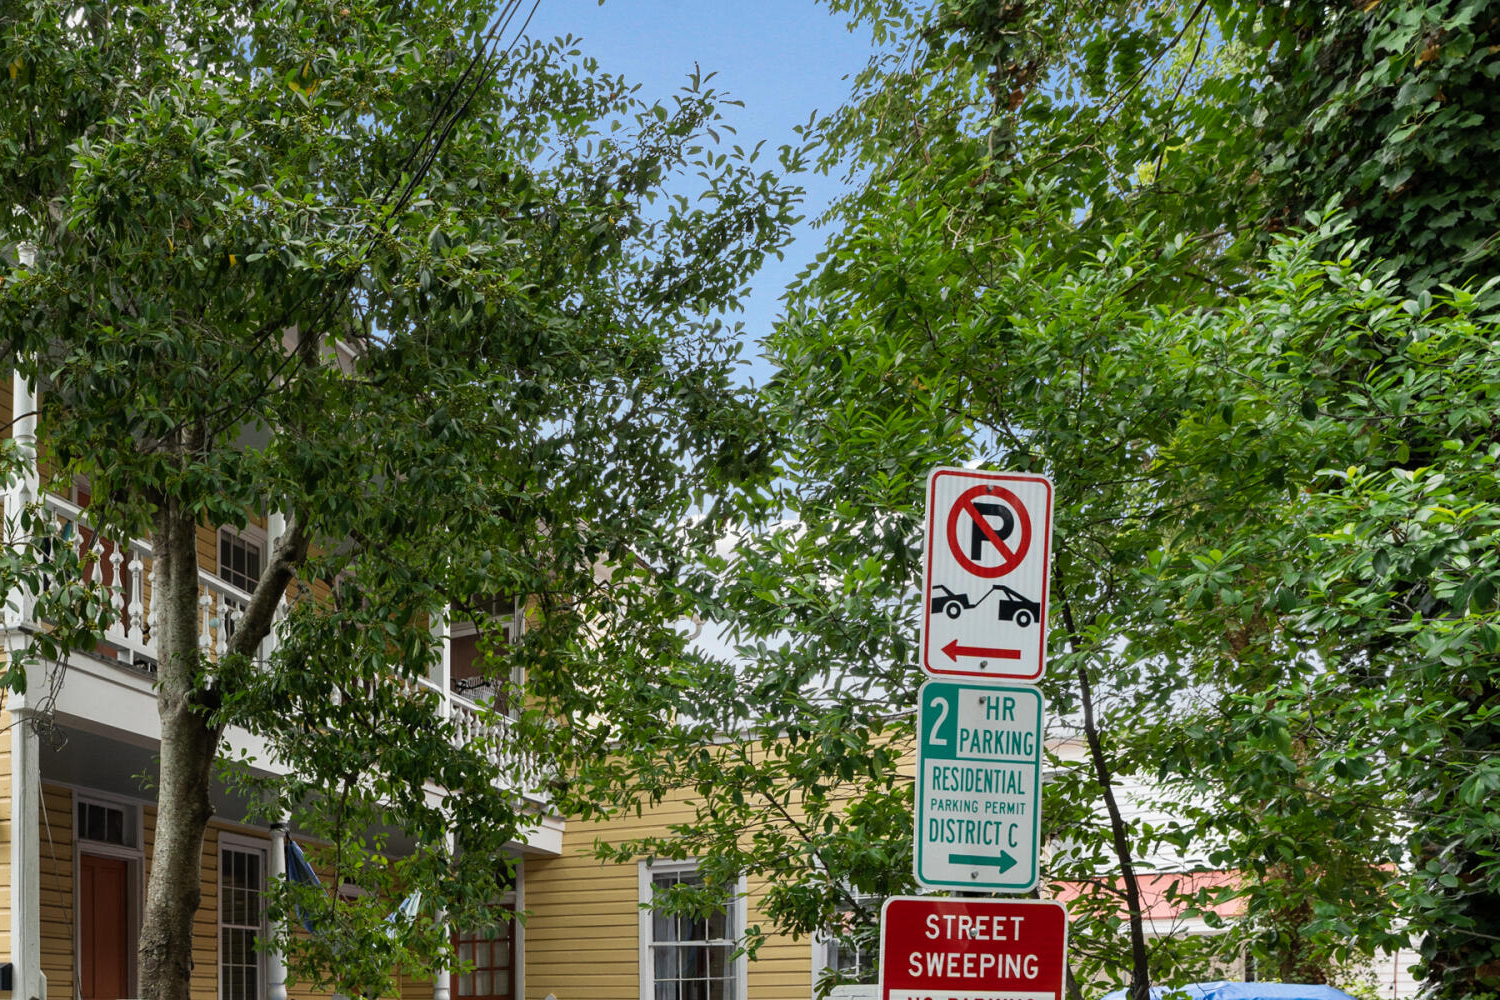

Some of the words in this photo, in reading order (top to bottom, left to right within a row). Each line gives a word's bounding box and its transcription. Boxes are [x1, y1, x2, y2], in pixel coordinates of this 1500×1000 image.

[929, 696, 949, 746] 2
[986, 696, 1016, 722] HR
[959, 728, 1034, 757] PARKING
[932, 765, 1026, 796] RESIDENTIAL
[930, 797, 979, 814] PARKING
[985, 800, 1026, 816] PERMIT
[929, 817, 1003, 846] DISTRICT
[1007, 822, 1019, 849] C
[925, 913, 1025, 941] STREET
[908, 951, 1039, 980] SWEEPING
